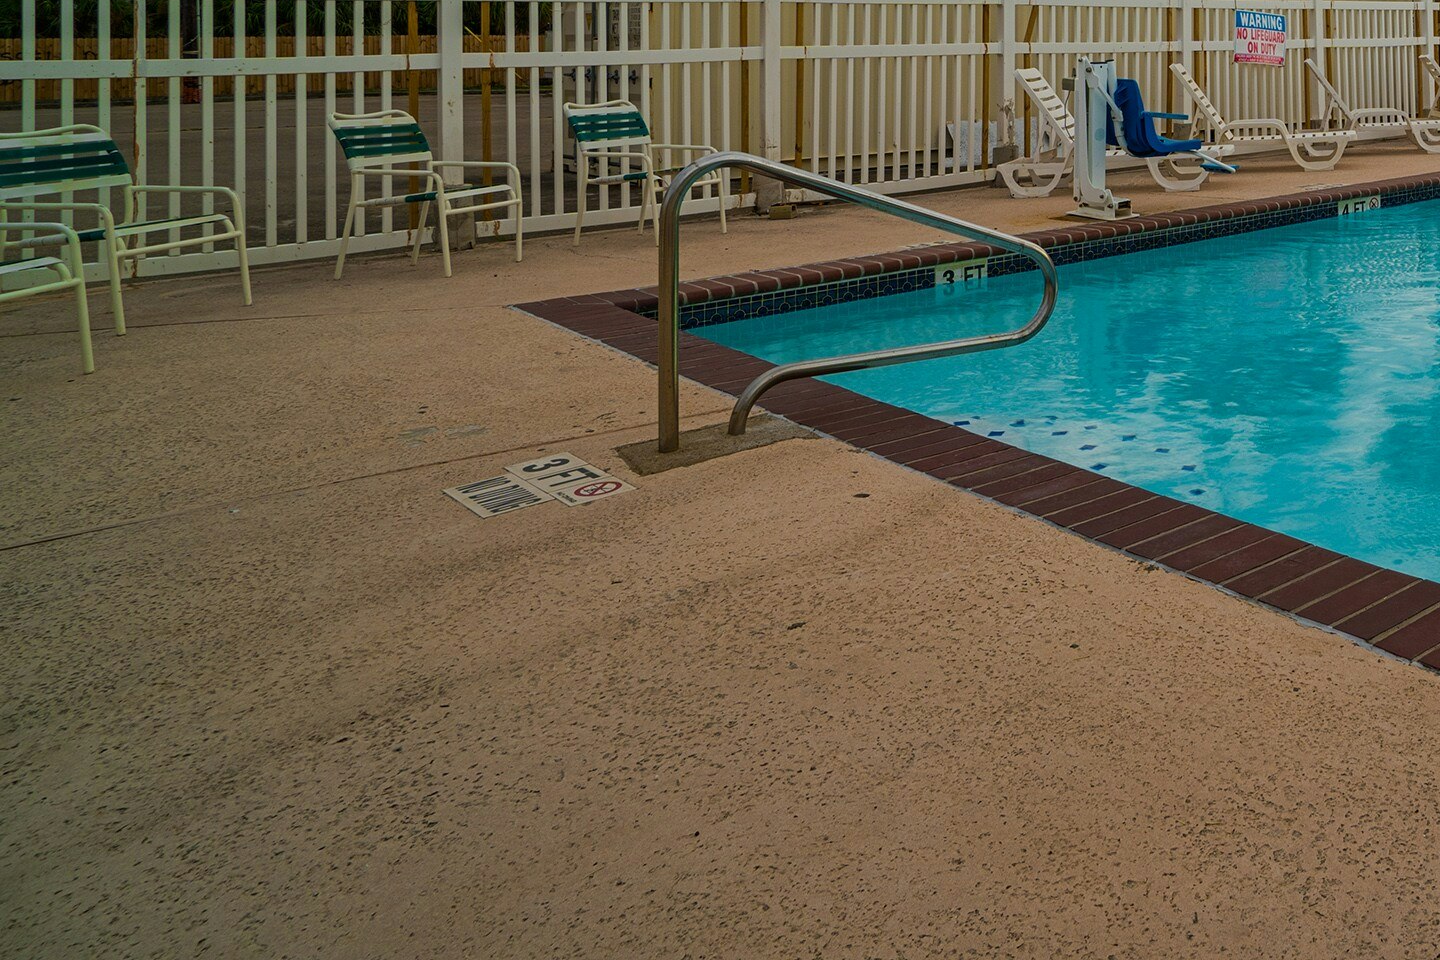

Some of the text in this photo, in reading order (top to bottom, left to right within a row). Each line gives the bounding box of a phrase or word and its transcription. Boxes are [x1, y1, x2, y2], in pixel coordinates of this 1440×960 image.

[1240, 12, 1283, 31] WARNING
[1236, 28, 1285, 44] NO LIFEGUARD
[1247, 41, 1277, 55] ON DUTY
[1342, 201, 1366, 215] 4 FT
[943, 264, 985, 284] 3 FT
[522, 458, 601, 487] 3 FT
[454, 475, 512, 494] NO
[468, 484, 542, 514] DIVING
